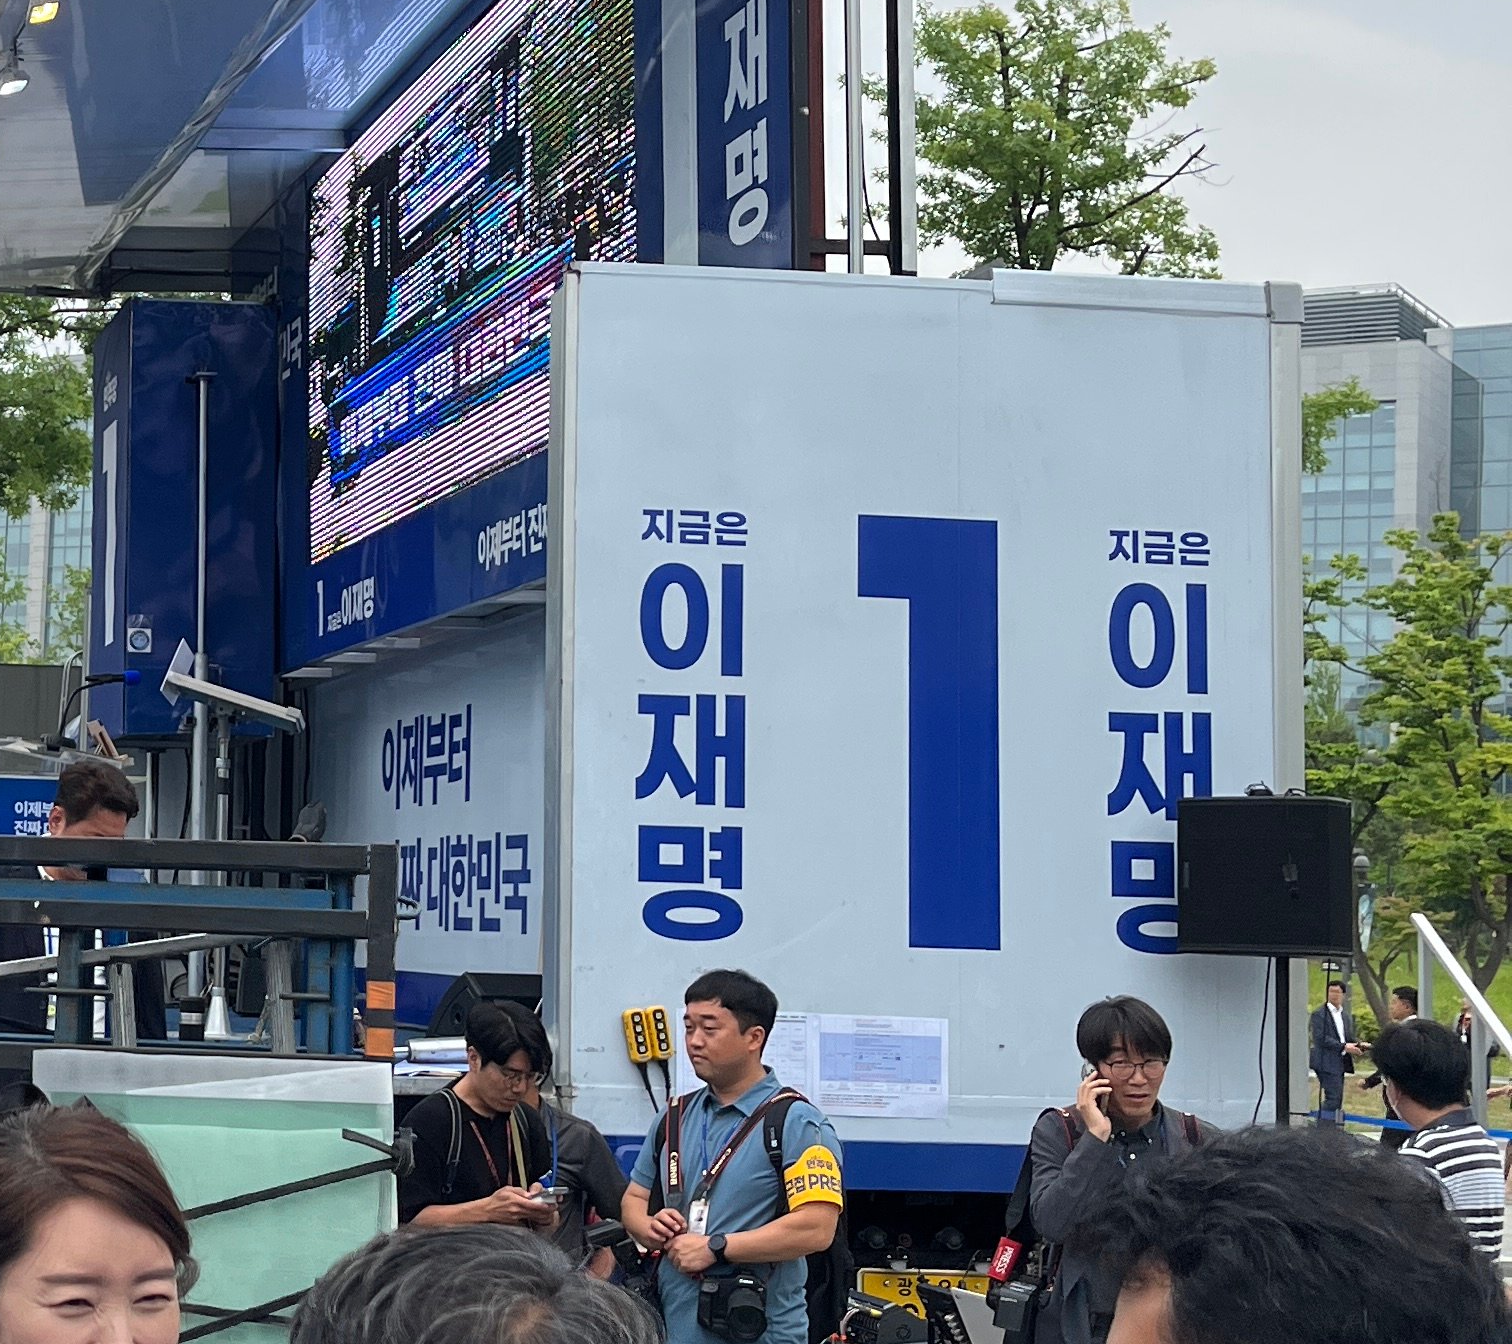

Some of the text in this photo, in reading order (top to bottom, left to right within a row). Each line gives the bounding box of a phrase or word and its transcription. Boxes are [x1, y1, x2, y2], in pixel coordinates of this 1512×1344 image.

[477, 509, 527, 571] 이제부터
[642, 509, 748, 546] 지금은
[1108, 529, 1211, 567] 지금은
[316, 579, 324, 637] 1
[341, 576, 375, 625] 이재명
[382, 703, 472, 810] 이제부터
[635, 562, 746, 941] 이재명
[857, 514, 1001, 951] 1
[14, 800, 55, 818] 이제부
[395, 831, 531, 935] 짜 대한민국
[995, 1245, 1015, 1275] PRESS
